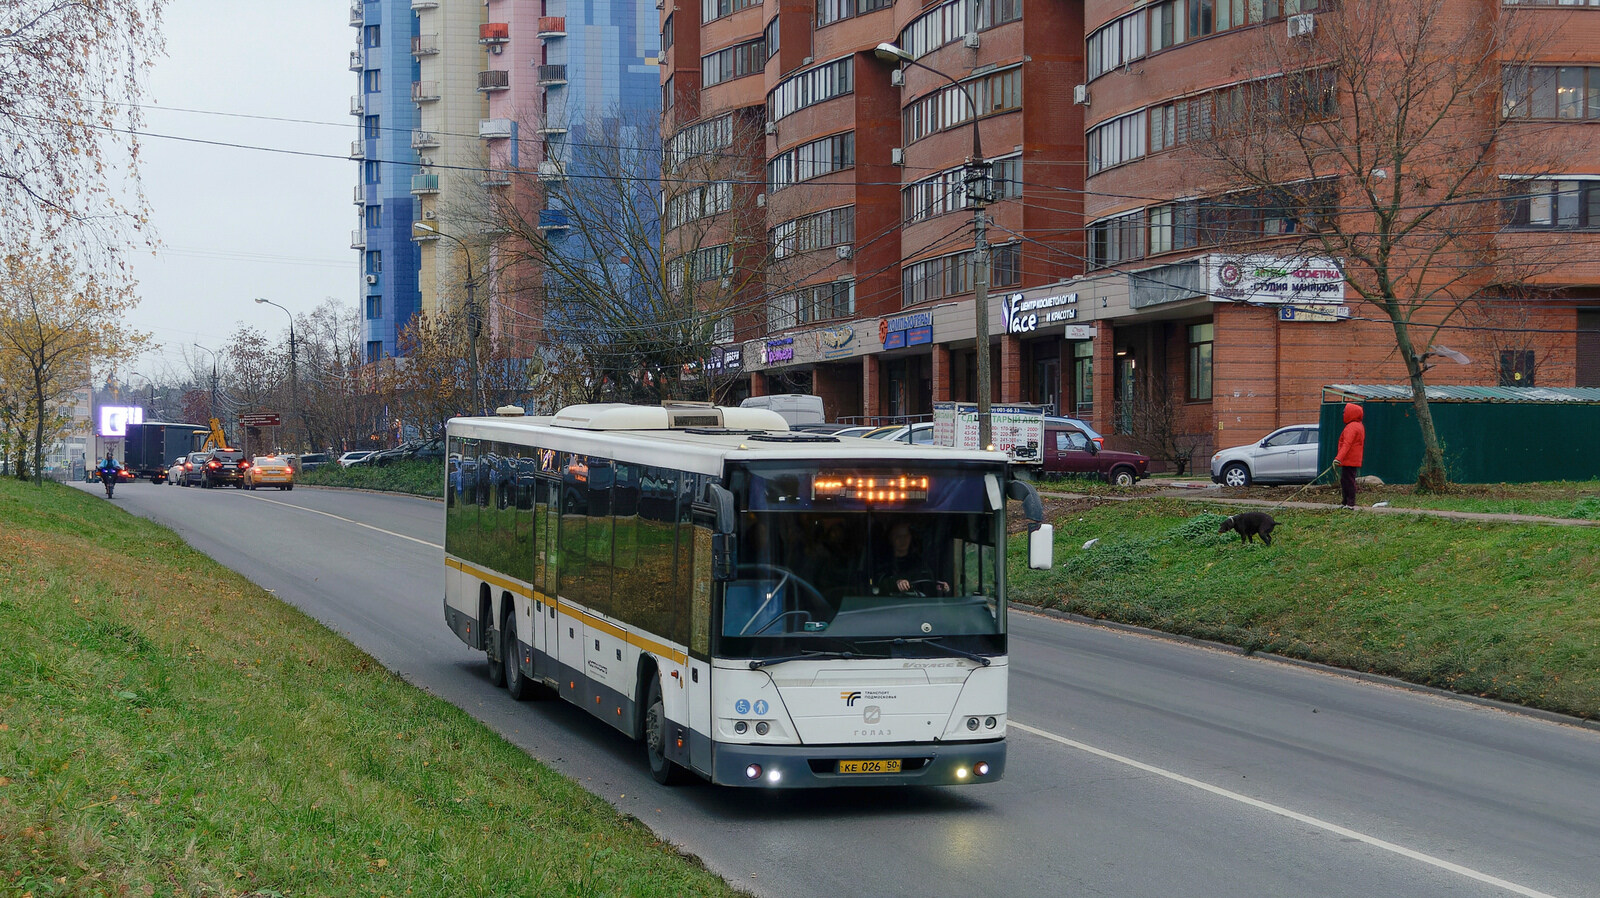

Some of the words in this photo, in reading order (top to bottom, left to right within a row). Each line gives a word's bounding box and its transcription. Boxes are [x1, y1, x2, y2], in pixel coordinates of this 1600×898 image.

[1290, 269, 1340, 279] КОСМЕТИКА
[1254, 283, 1288, 293] СТУДИЯ
[1291, 283, 1340, 293] МАНИКЮРА
[1020, 298, 1037, 311] ЦЕНТР
[1036, 293, 1077, 309] КОСМЕТОЛОГИИ
[1009, 293, 1038, 333] Face
[1045, 312, 1051, 322] И
[1050, 308, 1076, 322] КРАСОТЫ
[1285, 308, 1292, 318] 3
[887, 312, 931, 332] КОМПЬЮТЕРЫ
[992, 414, 1021, 424] ТАРЫЙ
[1022, 416, 1039, 424] АКБ
[999, 443, 1016, 452] UPS
[861, 762, 881, 772] 026
[886, 760, 898, 769] 50
